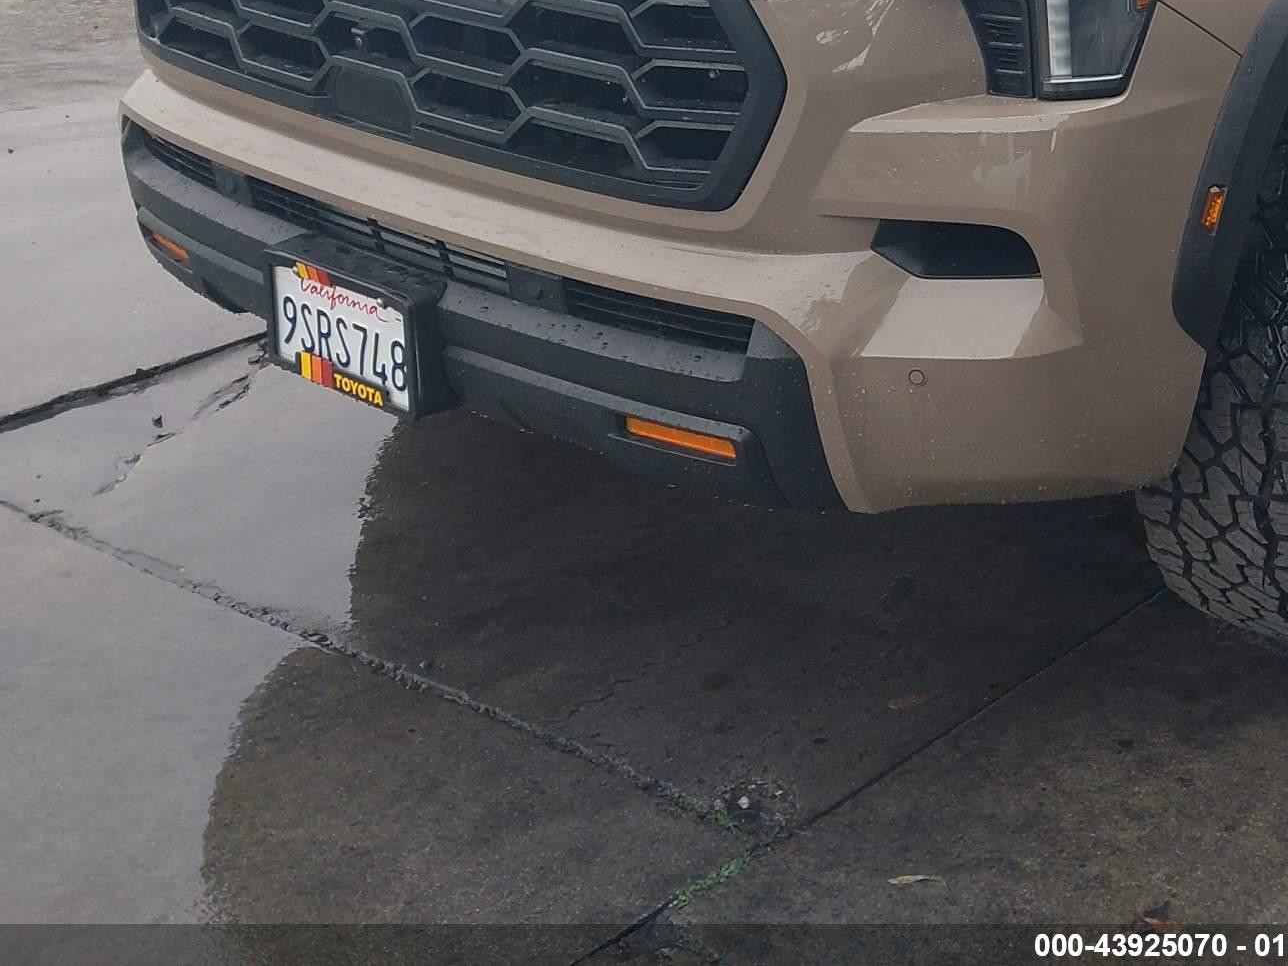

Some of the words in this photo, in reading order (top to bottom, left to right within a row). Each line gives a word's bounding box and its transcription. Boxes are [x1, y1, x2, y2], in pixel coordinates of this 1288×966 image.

[299, 277, 389, 323] California
[283, 296, 408, 392] 9SRS748
[333, 372, 384, 408] TOYOTA
